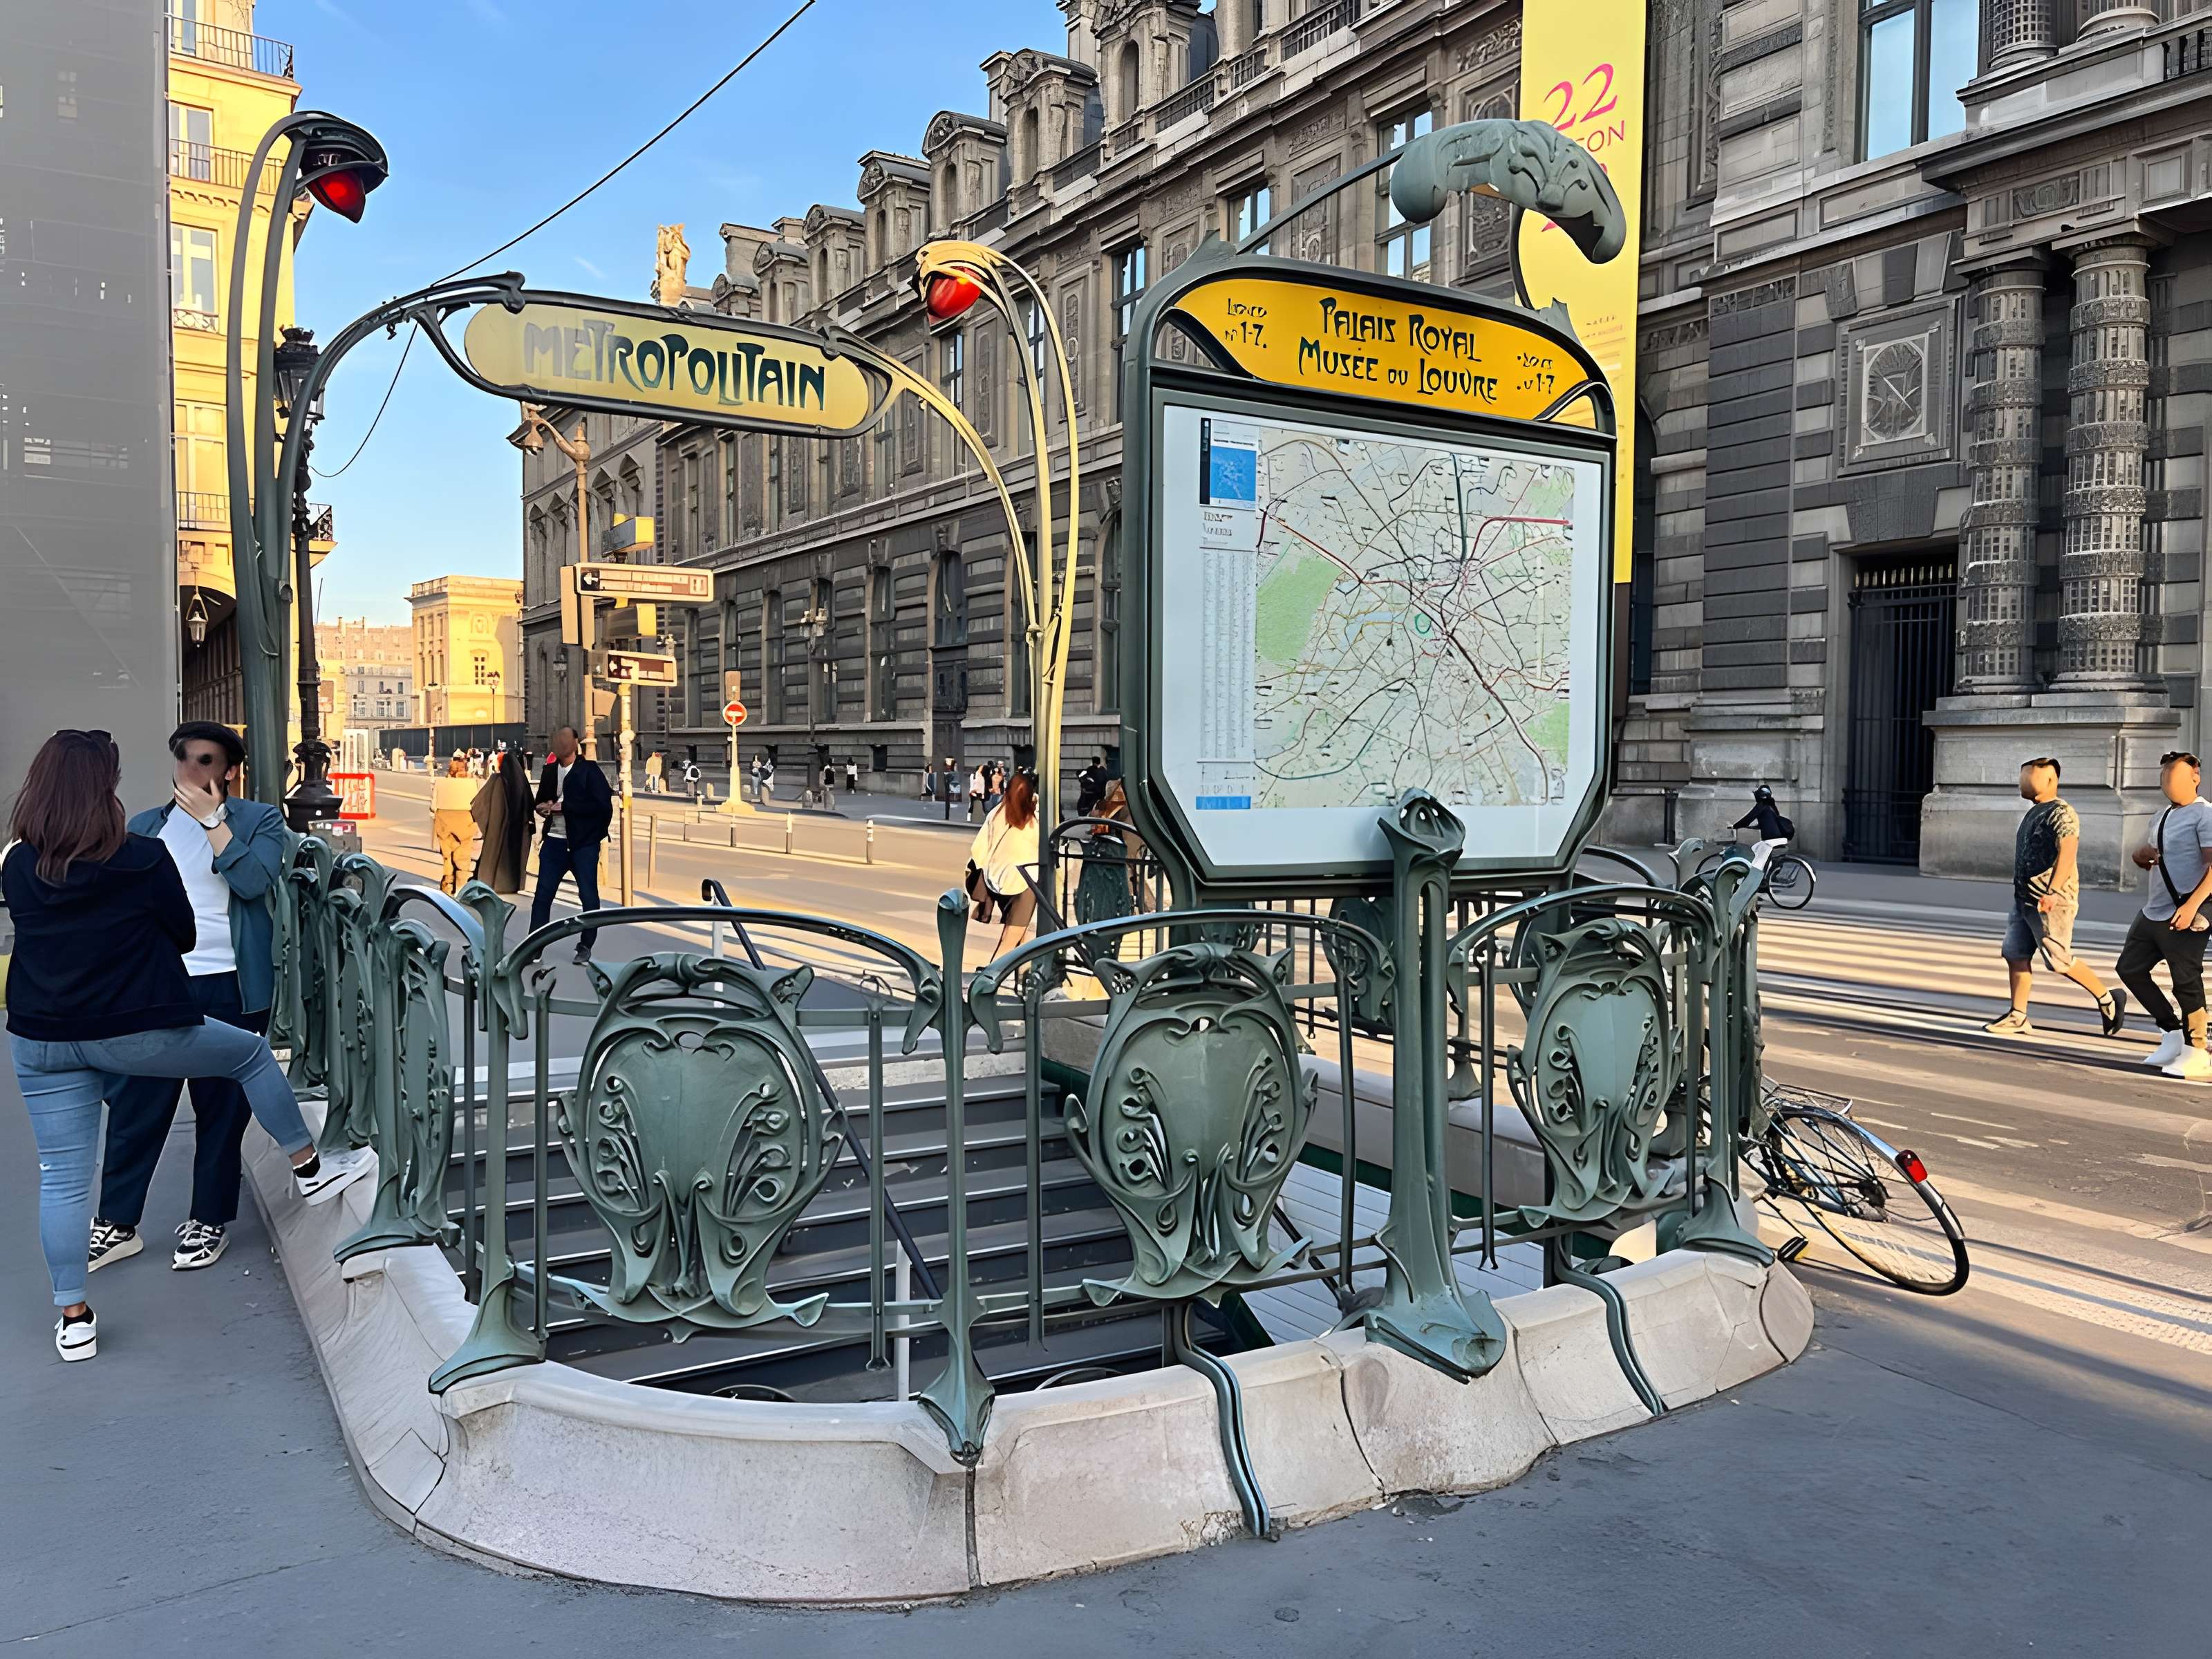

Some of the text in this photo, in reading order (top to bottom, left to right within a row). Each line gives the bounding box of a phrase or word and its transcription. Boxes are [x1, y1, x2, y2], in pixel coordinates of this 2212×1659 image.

[1319, 297, 1396, 343] PALAIS
[1409, 314, 1482, 362] ROYAL
[524, 319, 825, 412] METROPOLITAIN
[1416, 358, 1498, 405] LOUVRE
